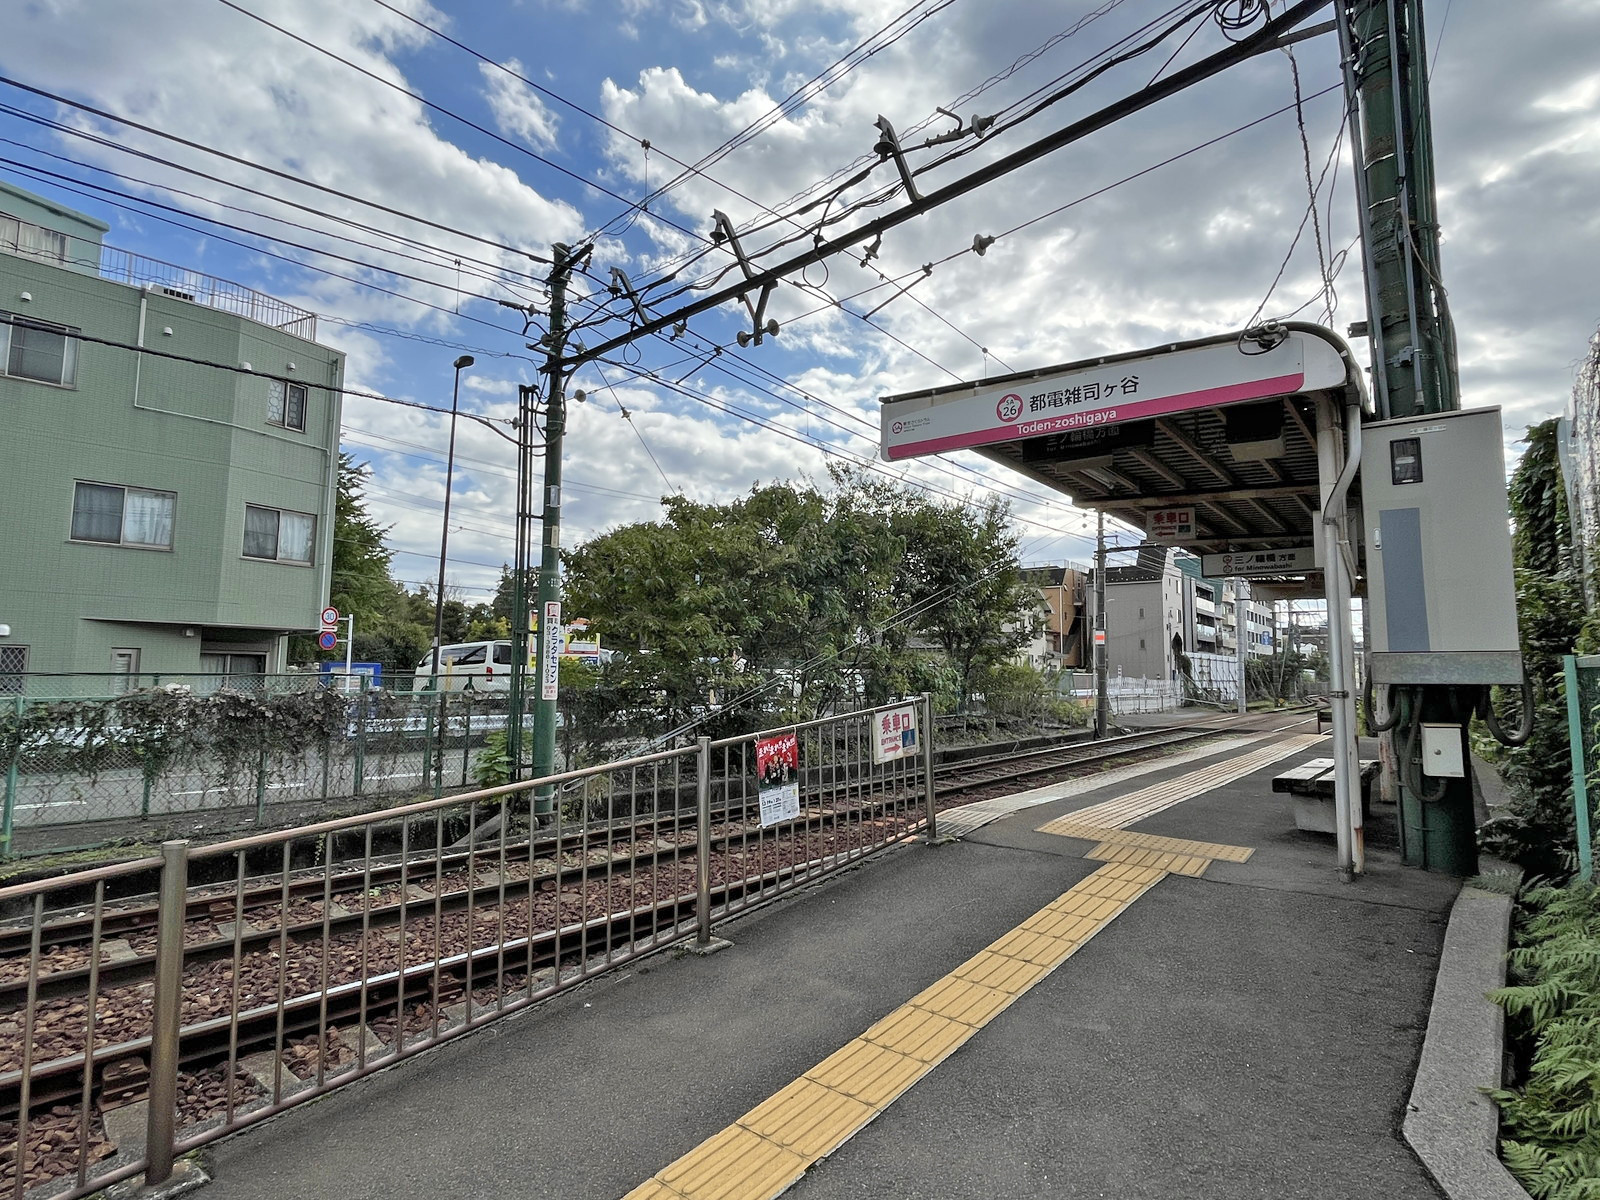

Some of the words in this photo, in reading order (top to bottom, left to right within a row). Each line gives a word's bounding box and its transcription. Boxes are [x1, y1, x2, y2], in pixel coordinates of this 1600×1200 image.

[1003, 405, 1017, 417] 26
[1017, 409, 1117, 435] Toden-zoshigaya
[1153, 511, 1189, 525] 乗車口
[1246, 562, 1293, 571] Minowabashi
[325, 612, 335, 621] 30
[882, 713, 910, 734] 乗車口
[881, 734, 902, 746] ENTRANCE
